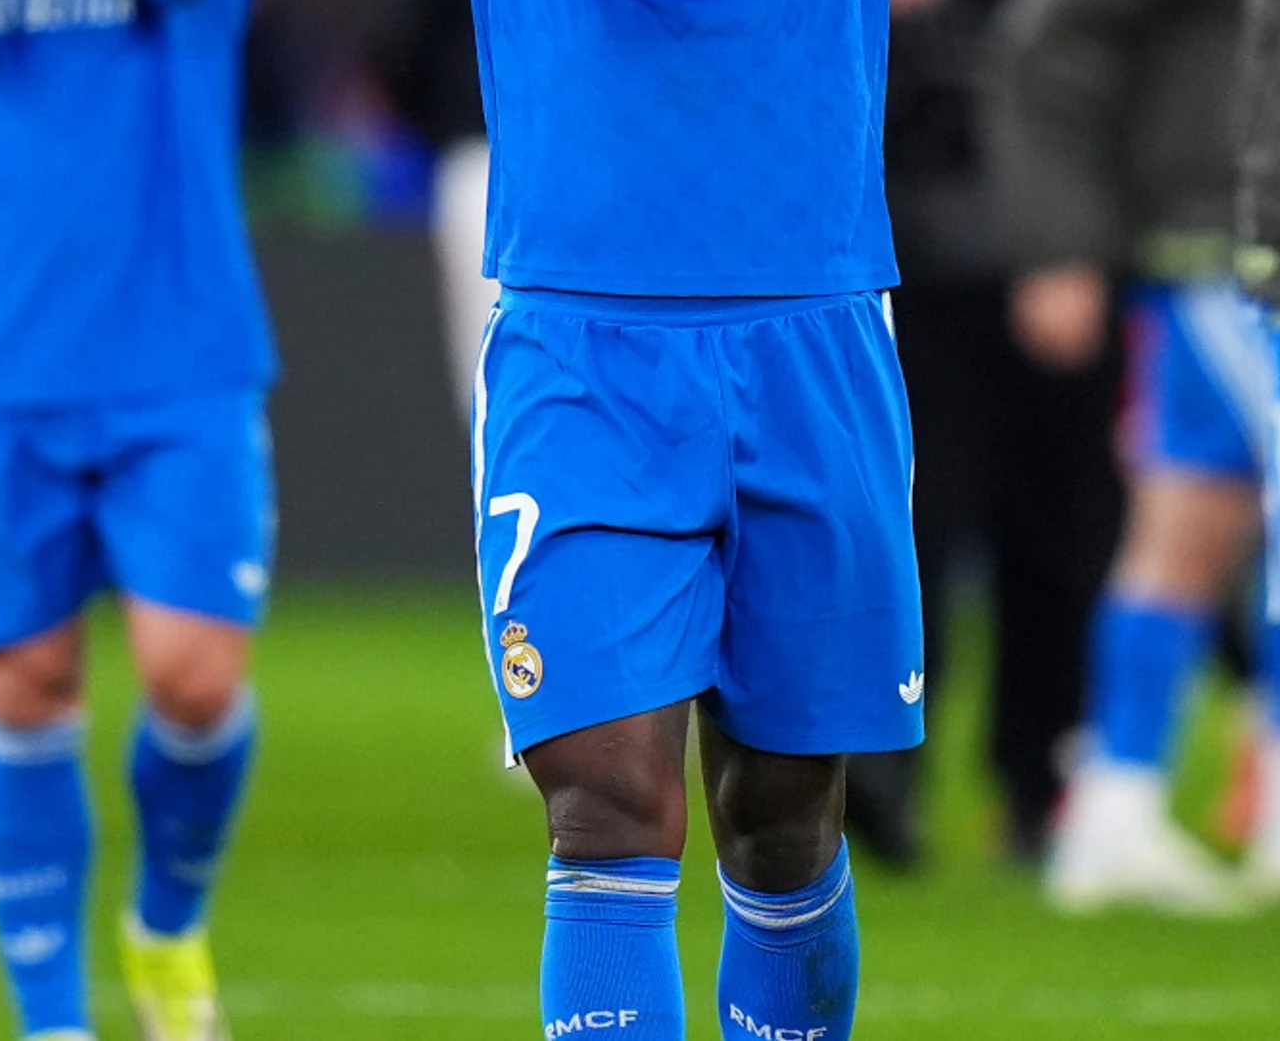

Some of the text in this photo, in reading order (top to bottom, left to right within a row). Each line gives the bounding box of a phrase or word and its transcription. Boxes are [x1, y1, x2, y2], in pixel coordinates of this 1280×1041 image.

[489, 492, 541, 617] 7
[545, 1009, 639, 1041] RMCF
[729, 1003, 827, 1041] RMCF
